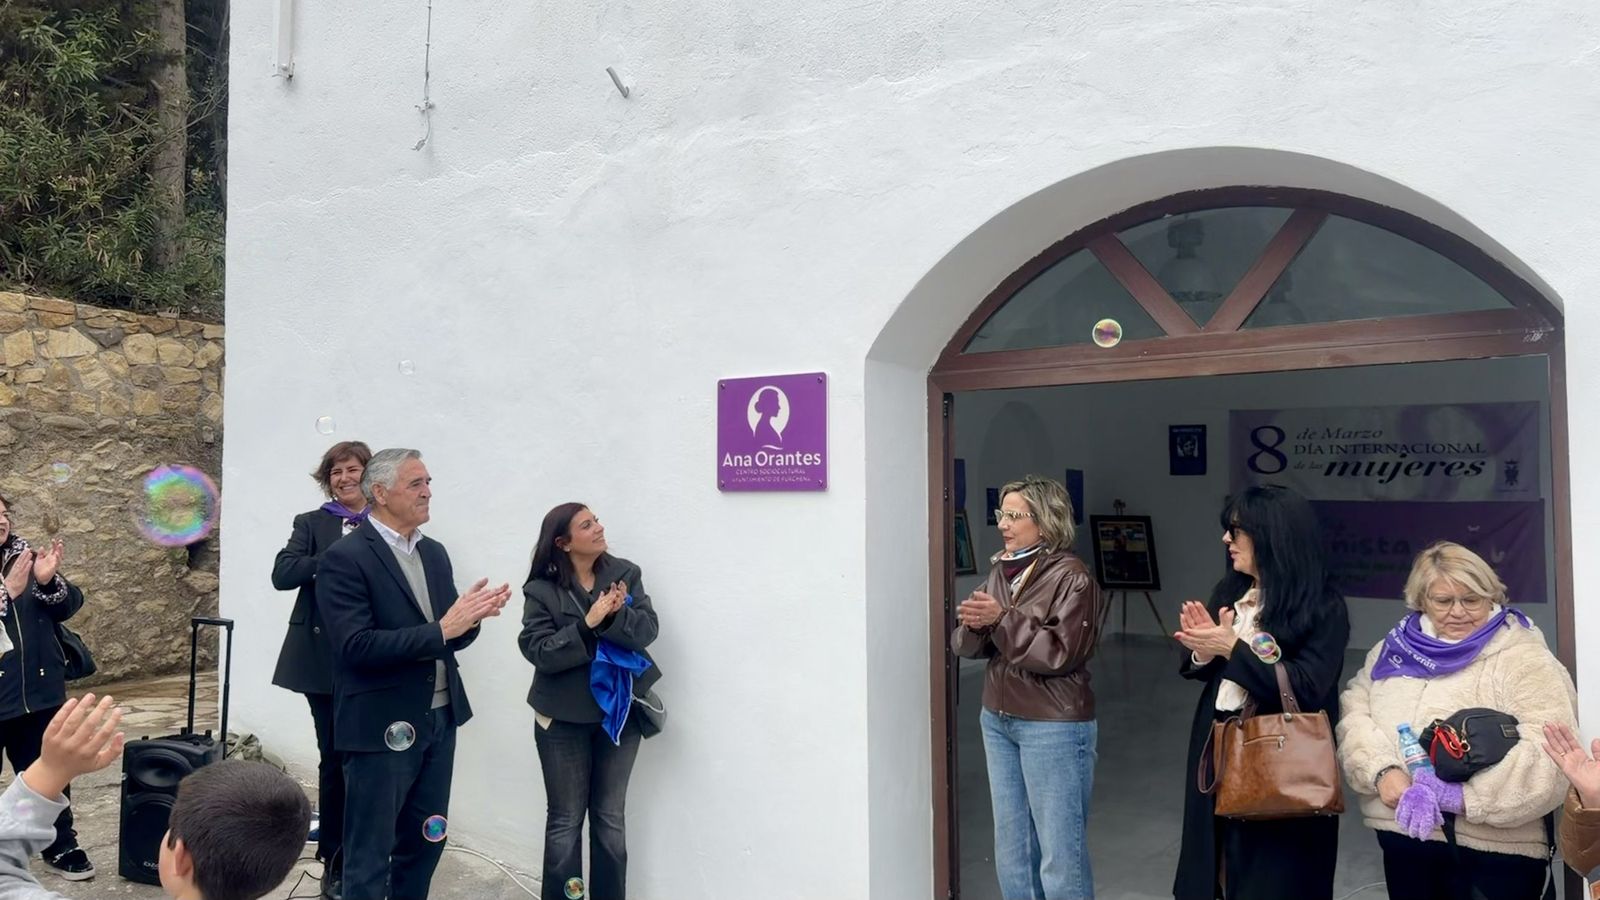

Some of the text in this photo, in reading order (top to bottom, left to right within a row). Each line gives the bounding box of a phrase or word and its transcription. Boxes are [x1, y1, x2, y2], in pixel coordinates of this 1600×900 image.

[722, 451, 821, 467] Ana Orantes
[1247, 425, 1383, 475] 8 de Marzo
[1294, 443, 1488, 455] DÍA INTERNACIONAL
[1323, 452, 1487, 484] mujeres
